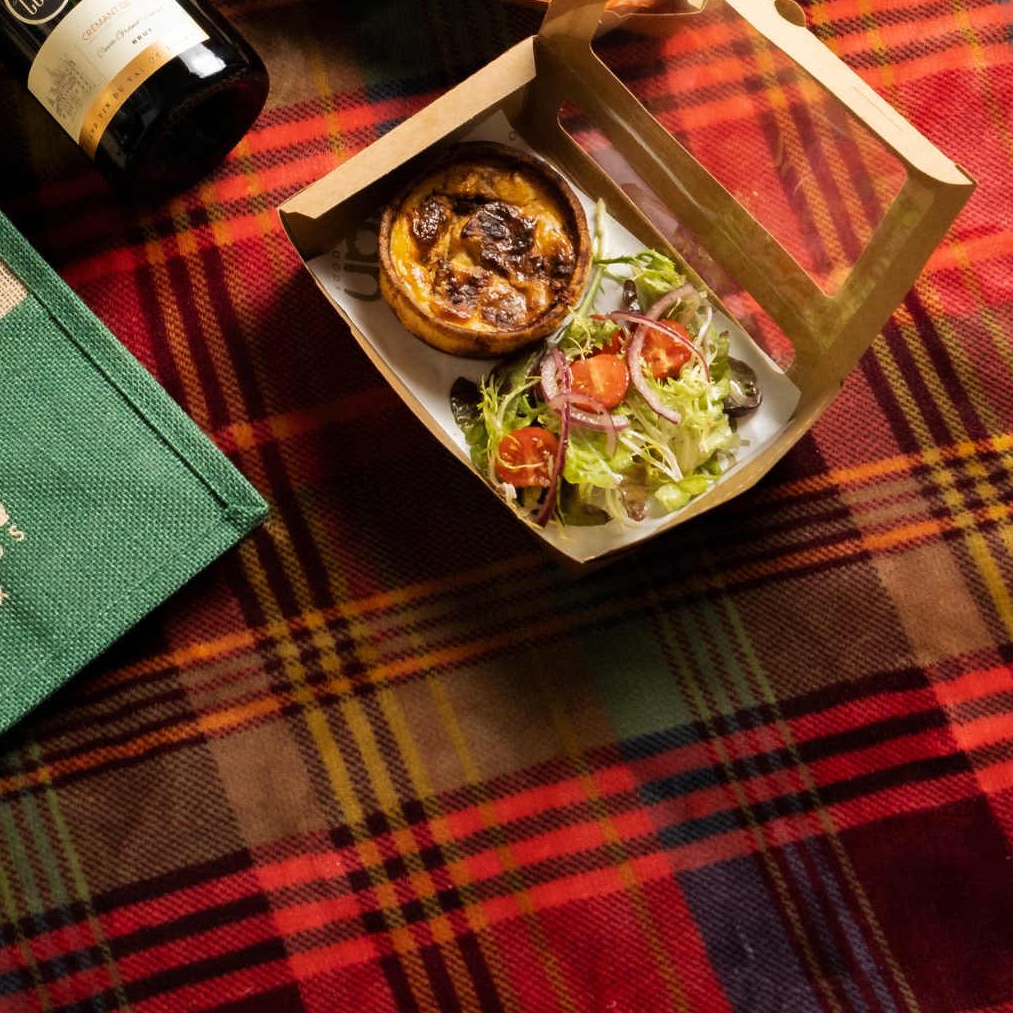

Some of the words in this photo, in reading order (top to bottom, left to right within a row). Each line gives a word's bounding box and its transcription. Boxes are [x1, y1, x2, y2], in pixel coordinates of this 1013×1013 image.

[82, 5, 120, 41] CRÉMANT
[116, 19, 140, 41] Grand
[131, 28, 153, 45] BRUT
[98, 102, 111, 119] VIN
[112, 86, 125, 99] DU
[127, 67, 146, 82] VAL
[148, 51, 162, 64] DE
